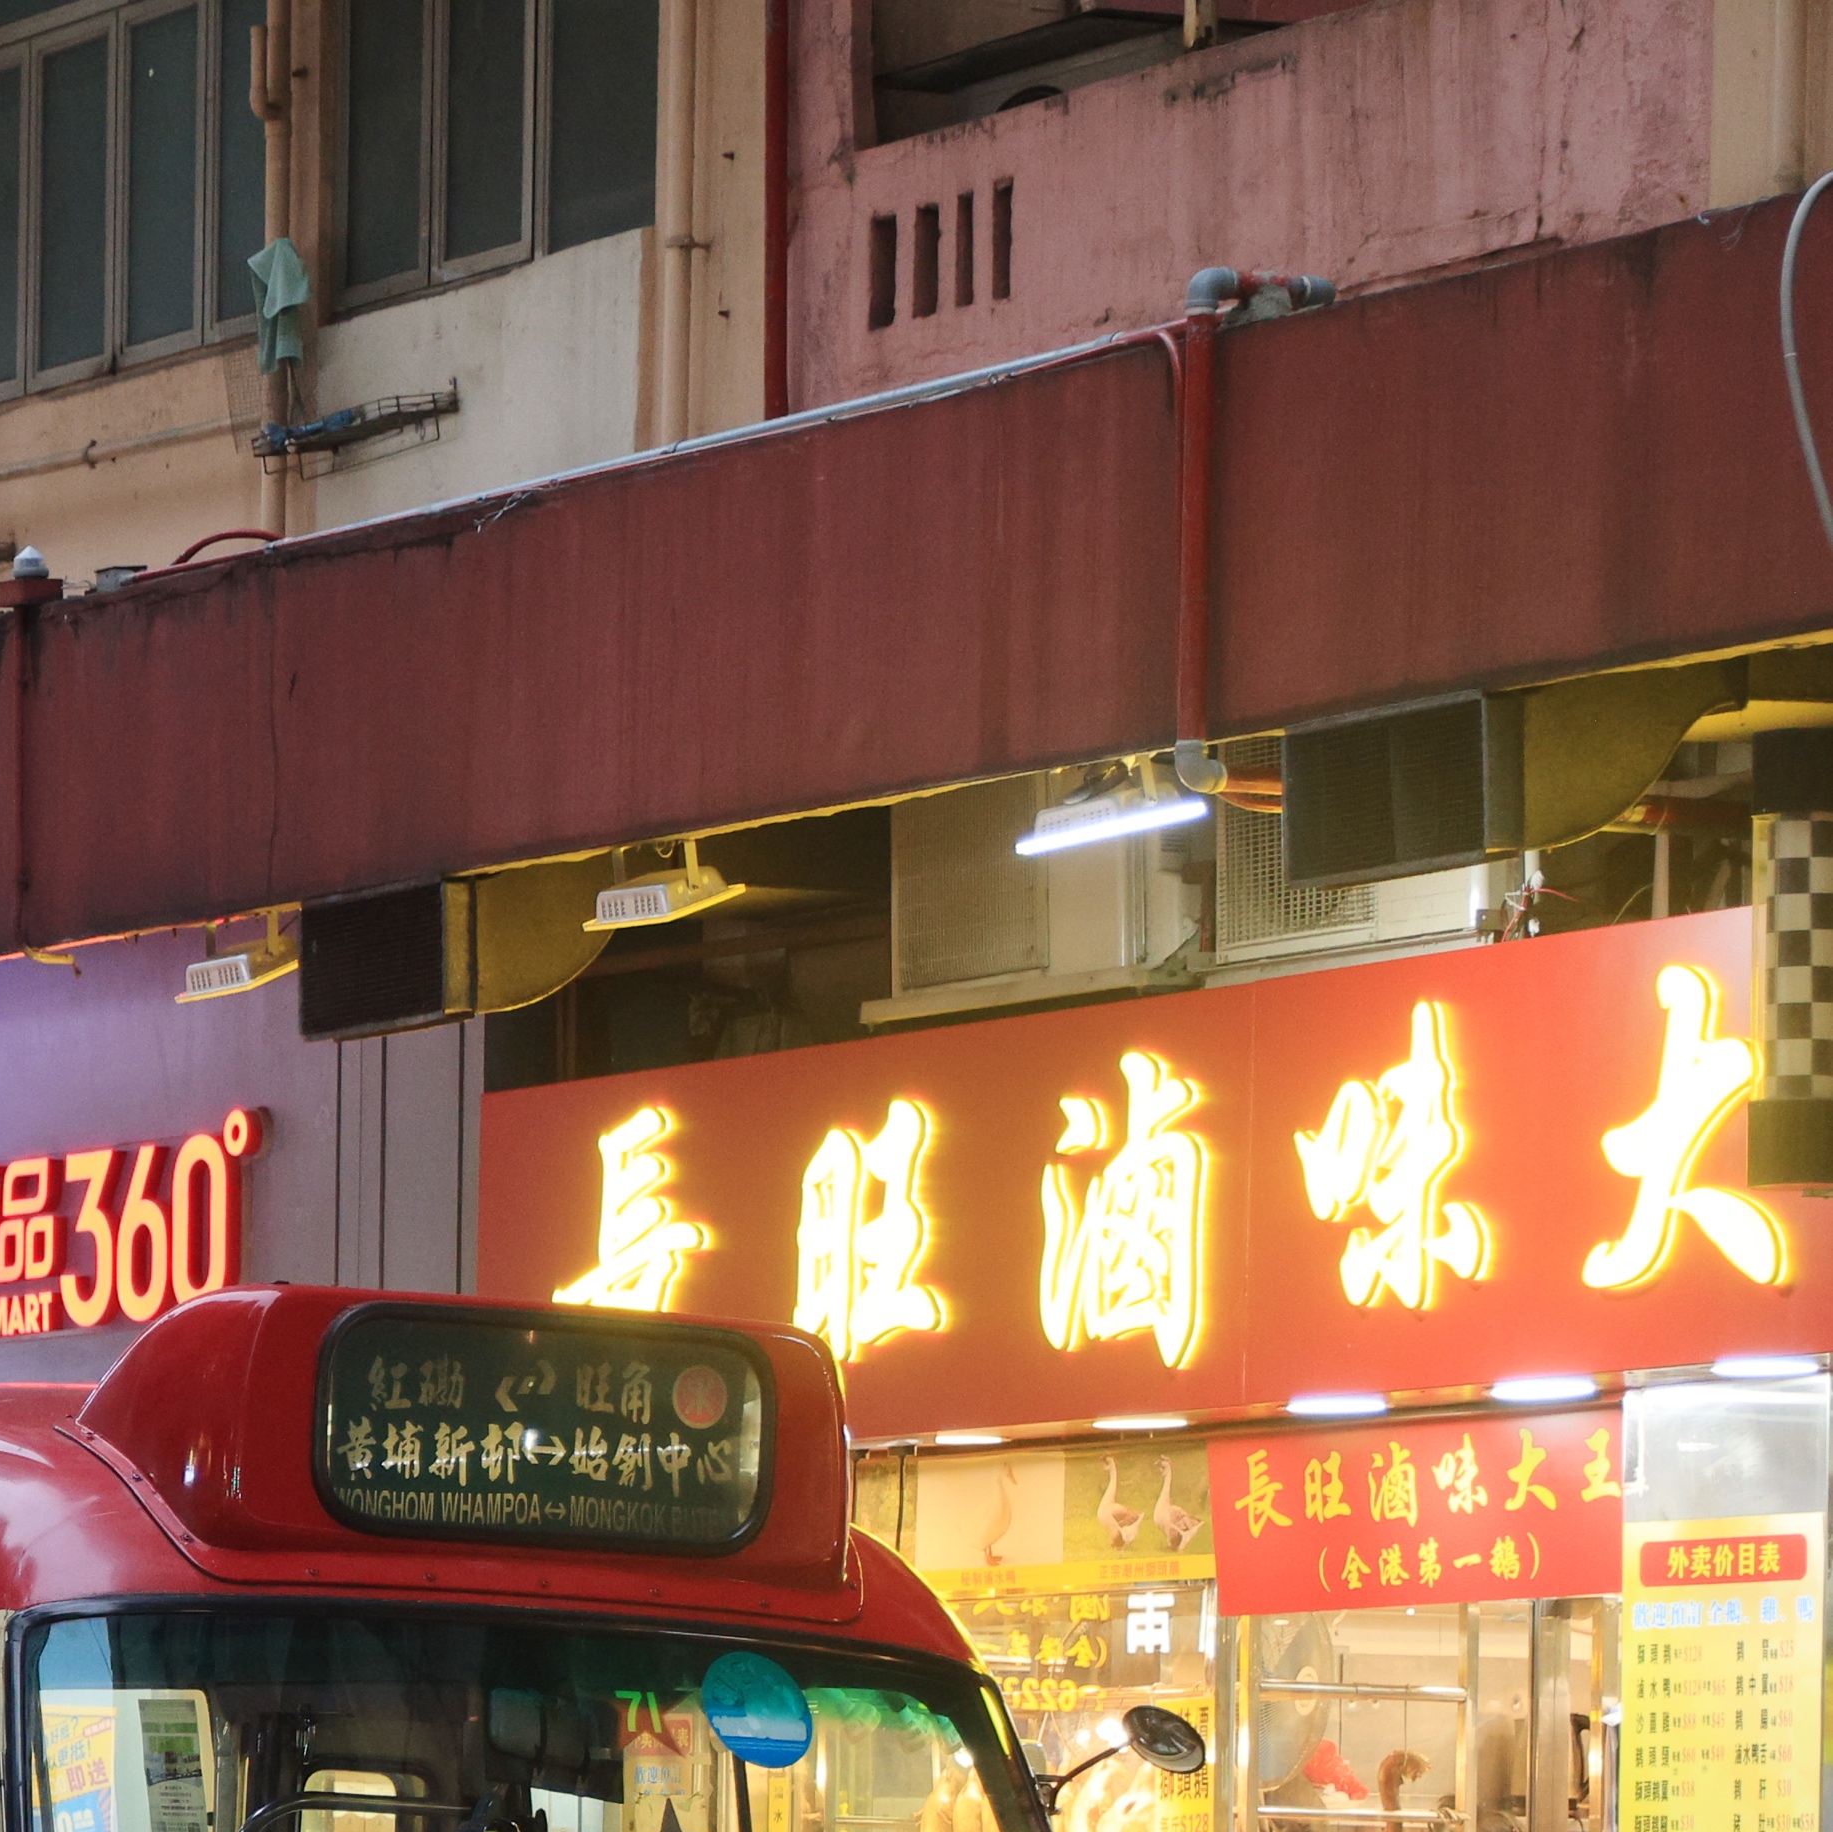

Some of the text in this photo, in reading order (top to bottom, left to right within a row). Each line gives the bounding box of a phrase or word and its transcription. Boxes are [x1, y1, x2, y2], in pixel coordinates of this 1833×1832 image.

[366, 1354, 654, 1425] 紅磡 旺角
[570, 1425, 732, 1498] 始創中心
[1233, 1427, 1623, 1539] 長旺滷味大王
[440, 1491, 542, 1526] WHAMPOA
[569, 1495, 672, 1535] MONGKOK
[1098, 1560, 1180, 1580] 正宗潮州獅頭鵝
[1667, 1541, 1781, 1579] 外卖价目表
[1633, 1601, 1704, 1629] 歡迎預訂
[1683, 1645, 1703, 1663] $128
[1683, 1681, 1702, 1696] $128
